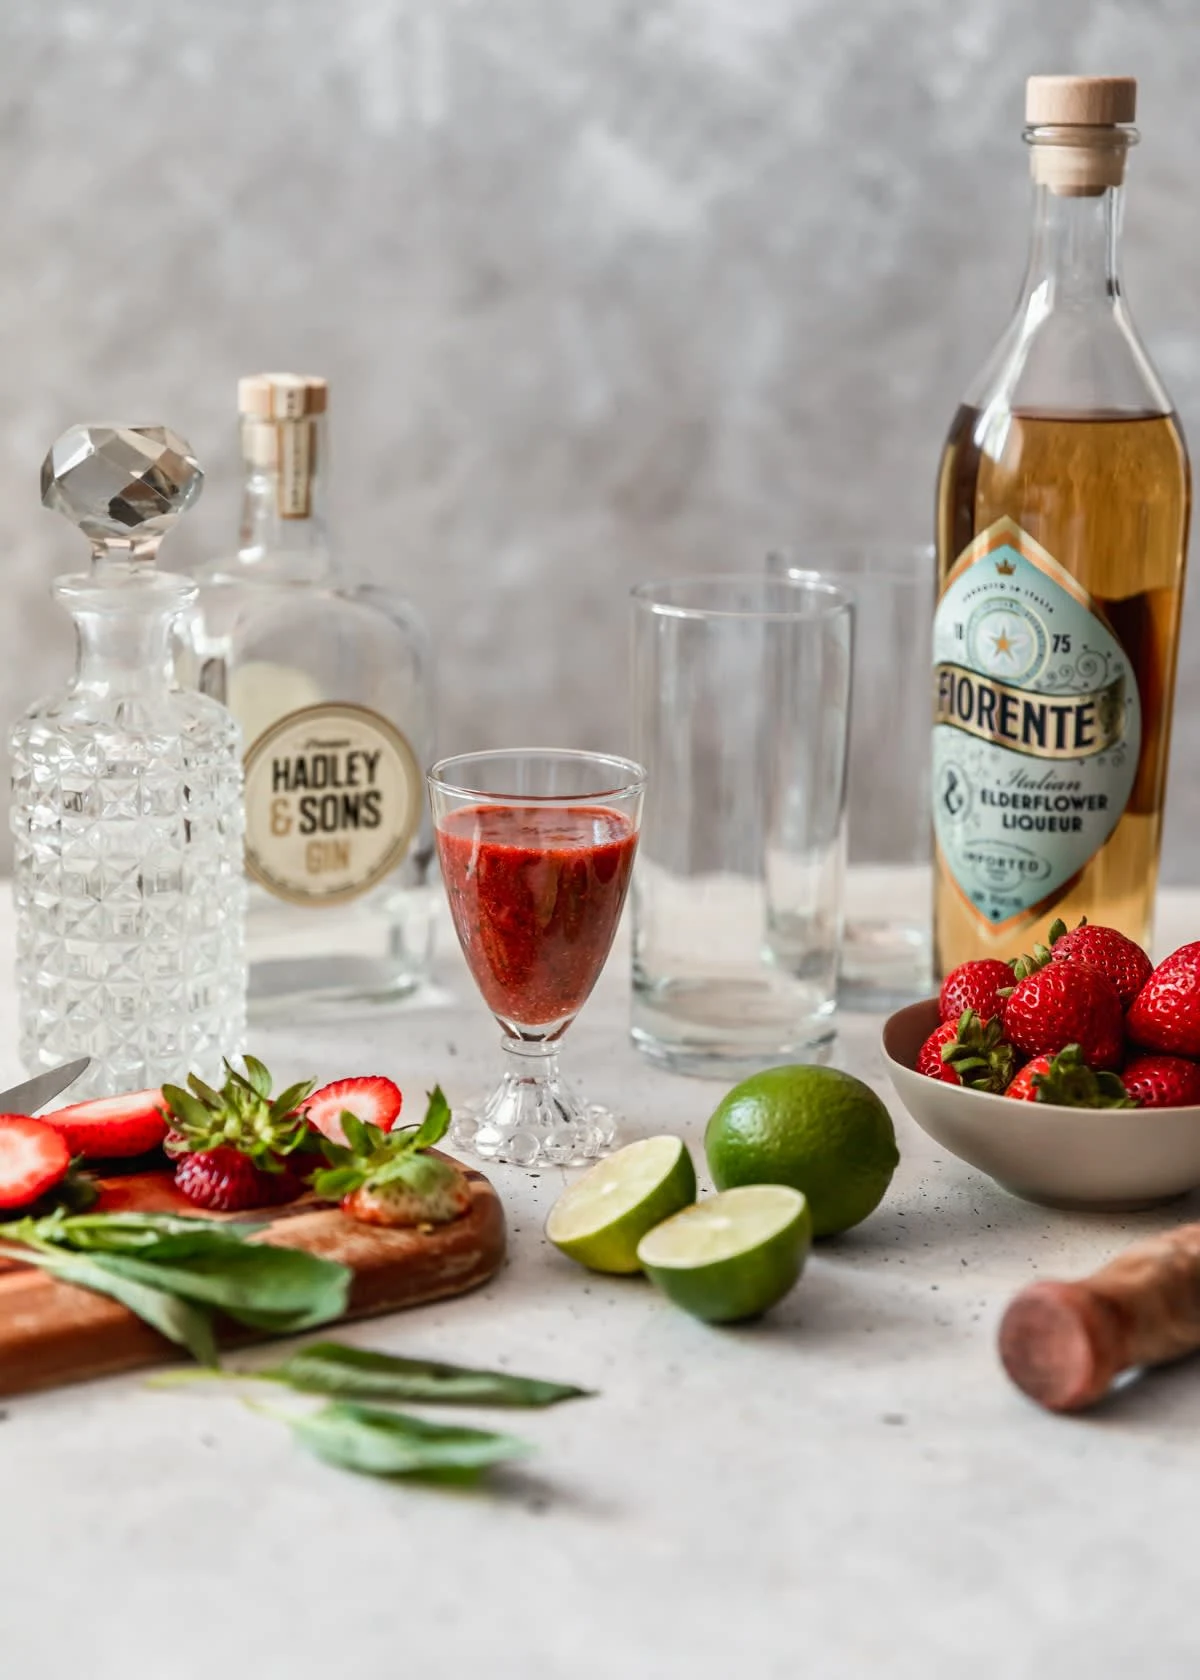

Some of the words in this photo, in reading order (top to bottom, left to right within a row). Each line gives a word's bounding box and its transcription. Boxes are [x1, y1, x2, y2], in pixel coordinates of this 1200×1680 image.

[1052, 633, 1071, 653] 75
[938, 670, 1095, 750] FIORENTE
[271, 749, 381, 793] HADLEY
[270, 798, 293, 838] &
[299, 790, 382, 835] SONS
[980, 788, 1109, 813] ELDERFLOWER
[1002, 812, 1083, 833] LIQUEUR
[305, 840, 352, 875] GIN
[963, 851, 1039, 873] IMPORTED
